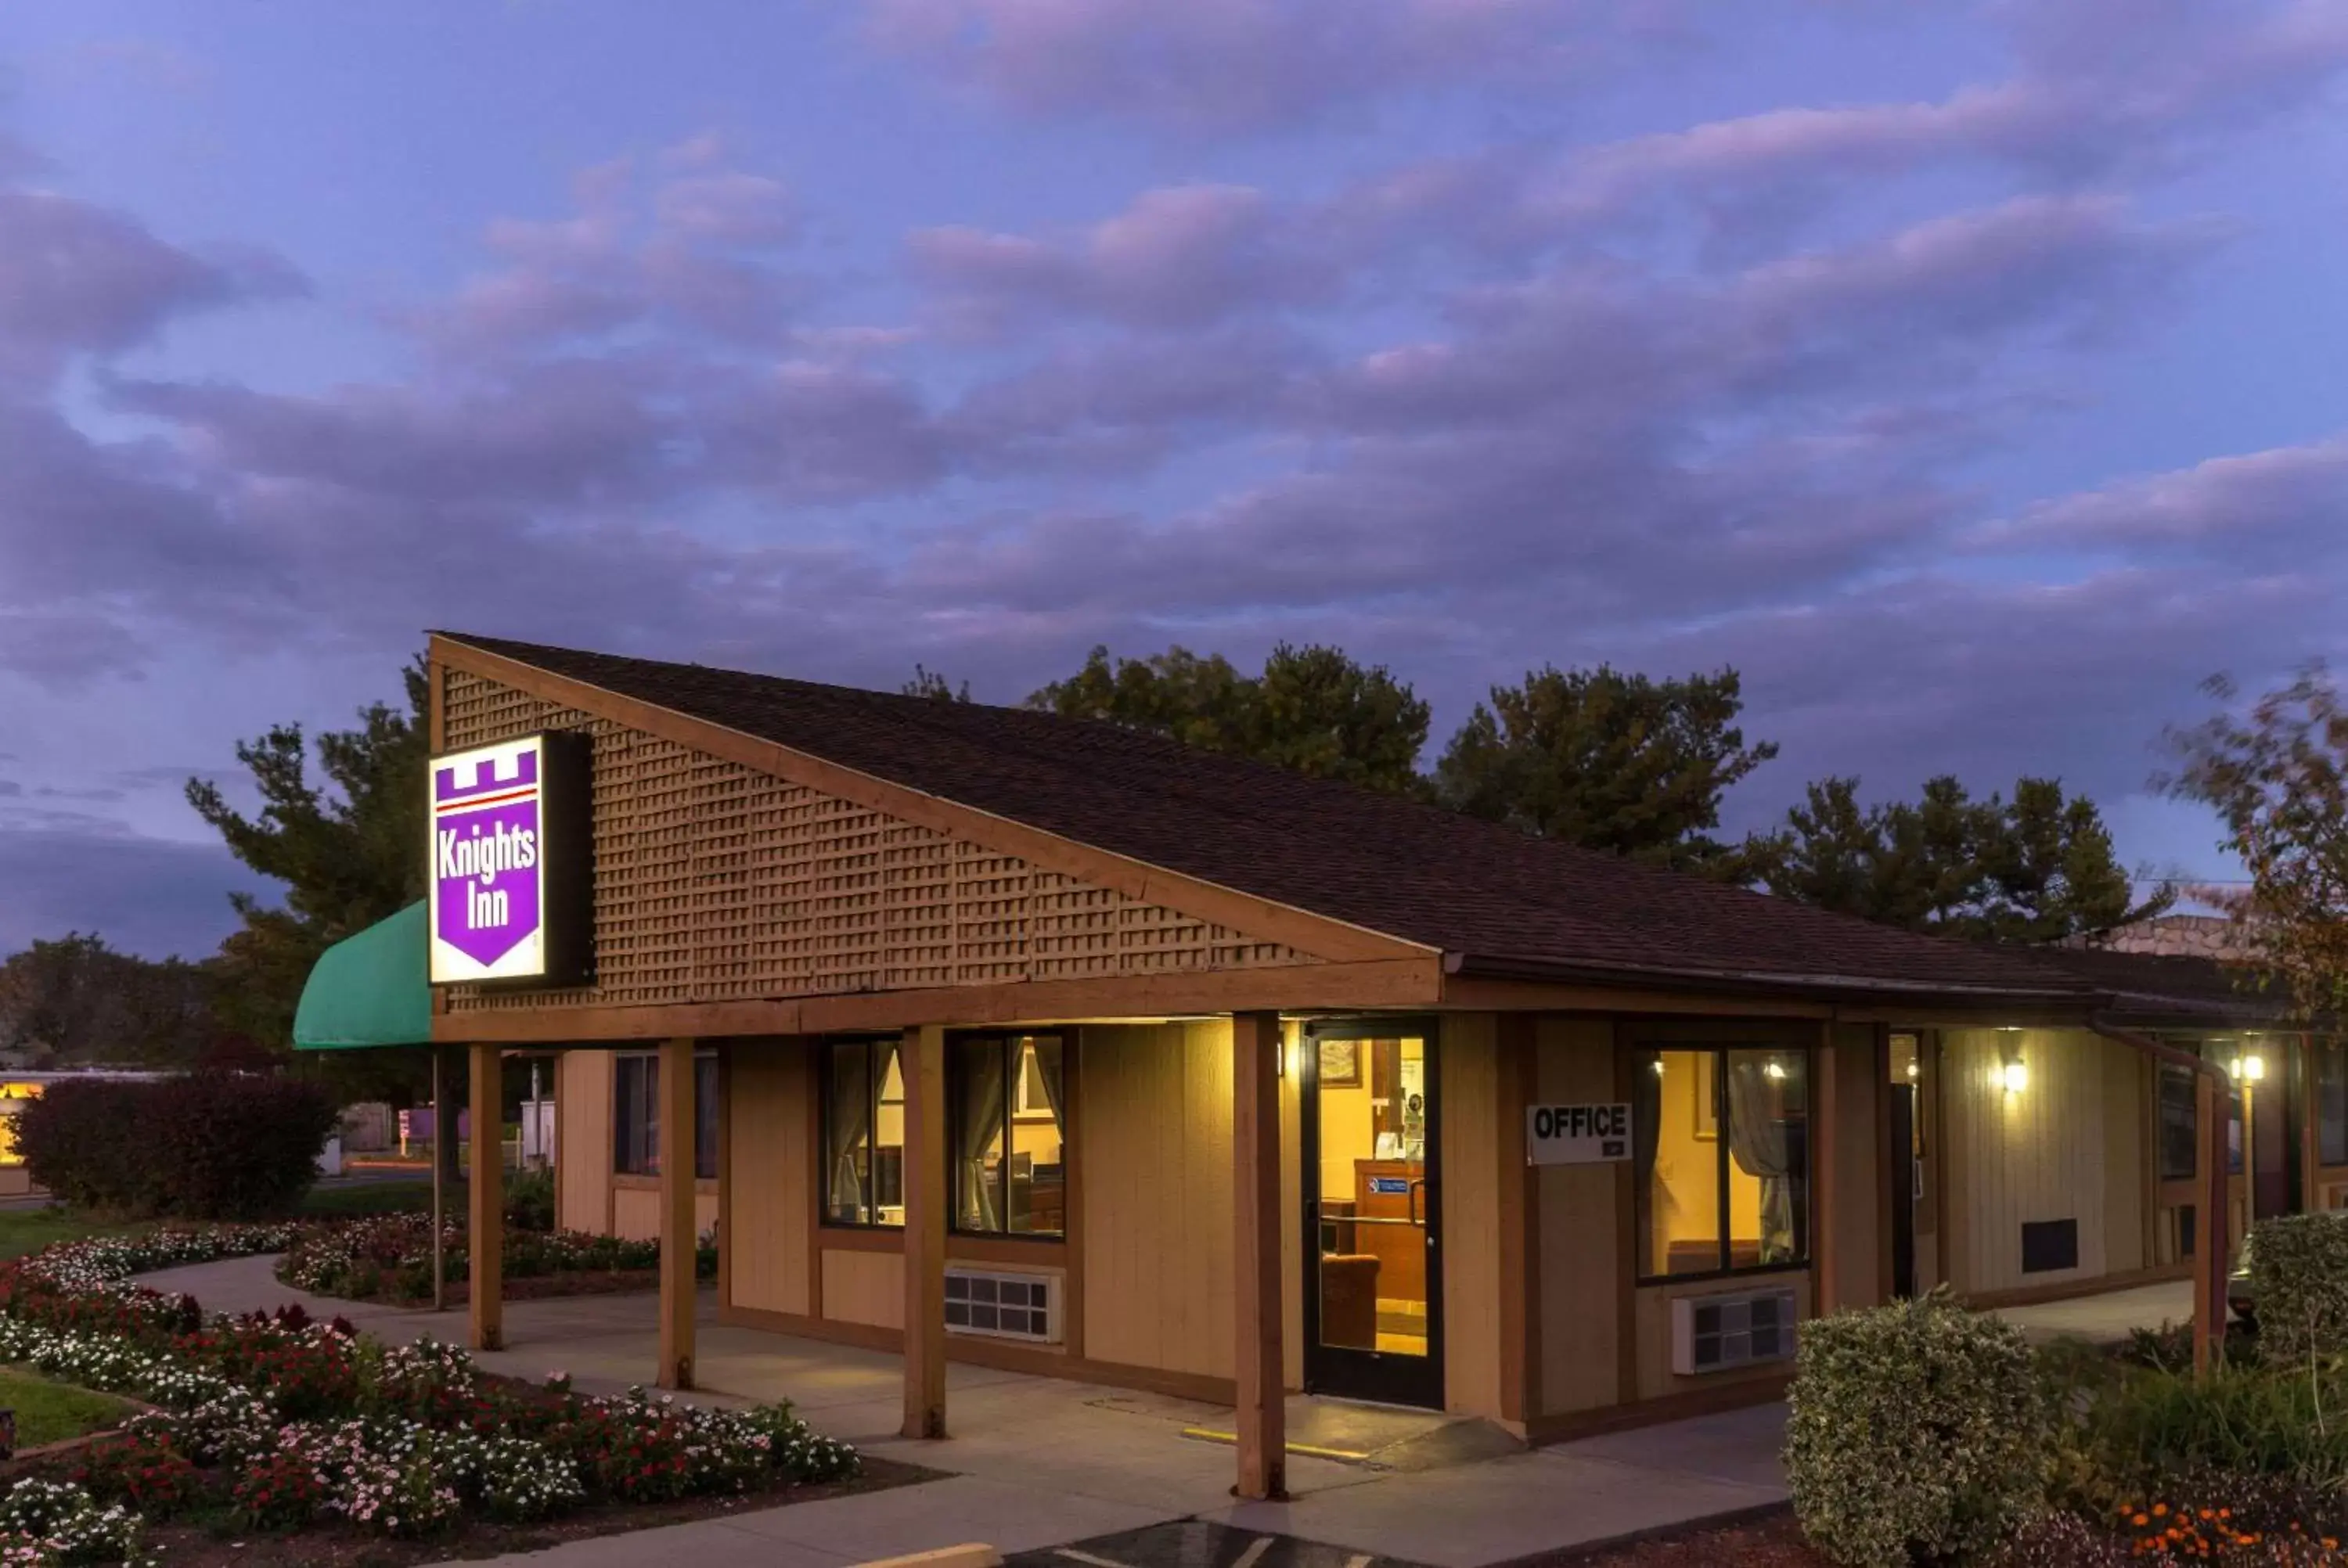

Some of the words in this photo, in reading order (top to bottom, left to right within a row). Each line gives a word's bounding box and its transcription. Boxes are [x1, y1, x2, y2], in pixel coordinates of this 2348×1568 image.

[439, 821, 536, 885] Knights
[467, 880, 508, 929] Inn
[1534, 1106, 1626, 1139] OFFICE
